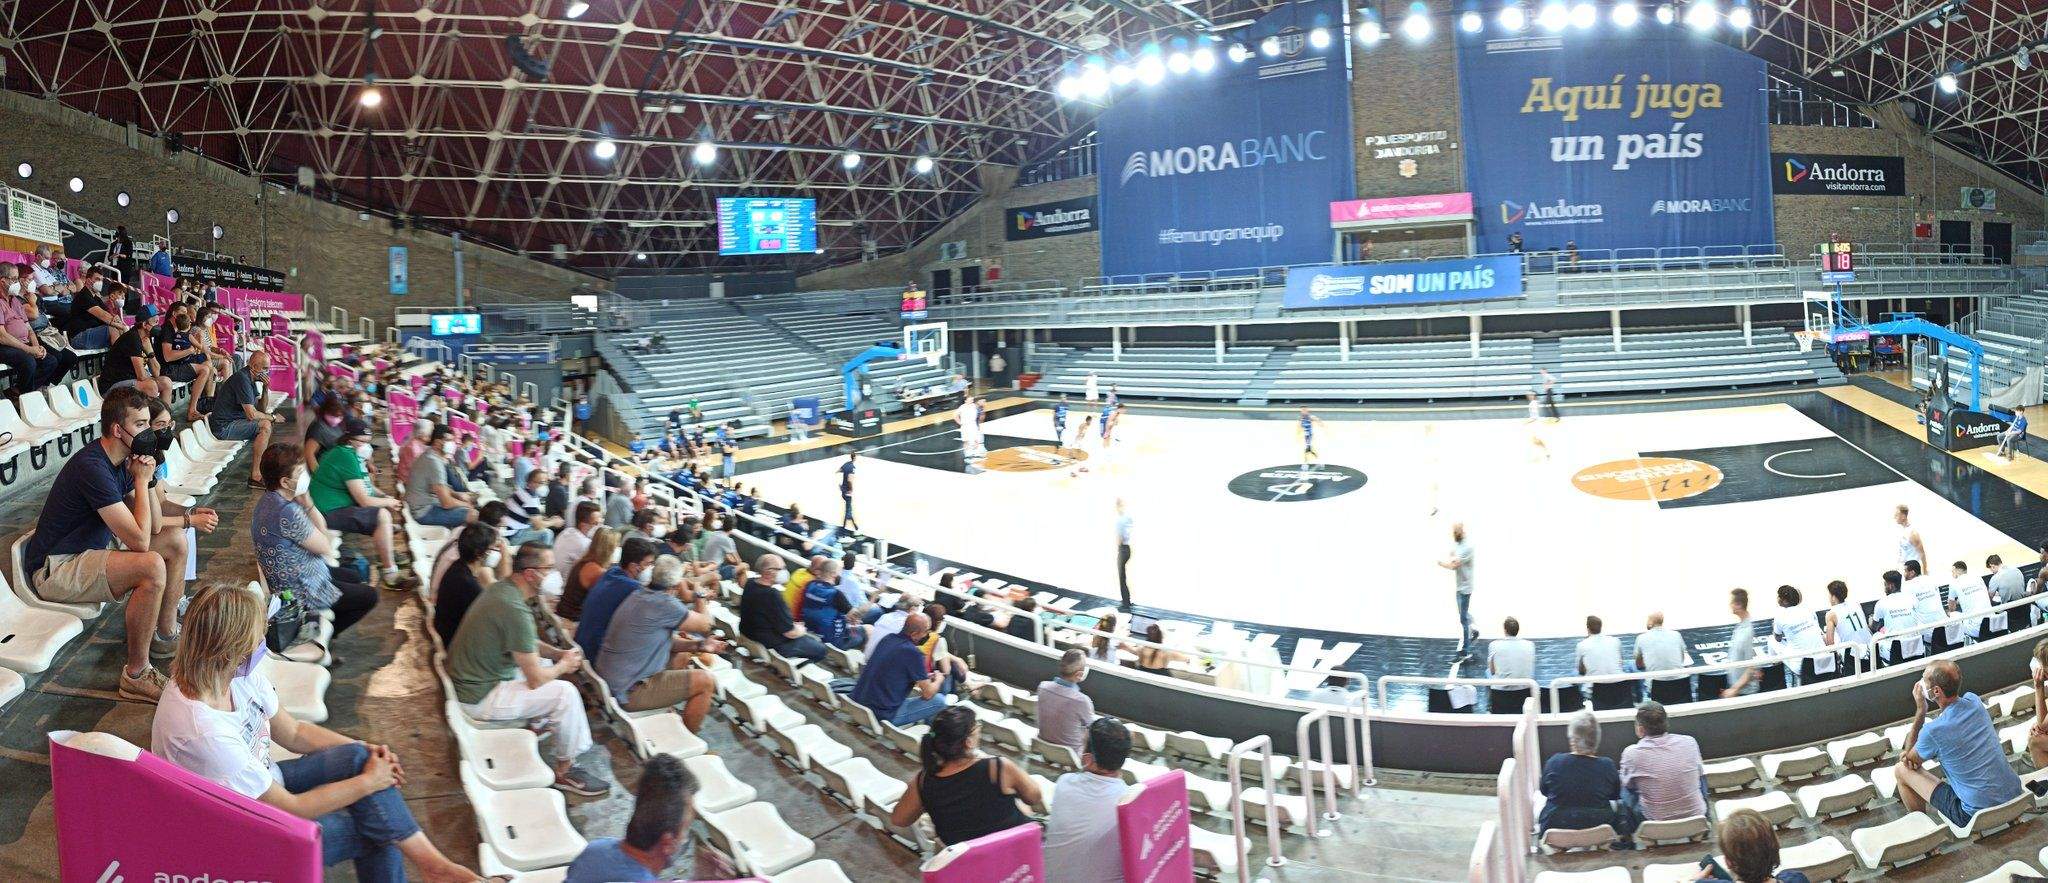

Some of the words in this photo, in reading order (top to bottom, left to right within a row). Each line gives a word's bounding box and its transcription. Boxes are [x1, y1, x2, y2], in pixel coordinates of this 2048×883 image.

[1520, 74, 1626, 122] Aquí
[1630, 74, 1723, 119] juga
[1150, 131, 1327, 178] MORABANC
[1550, 133, 1605, 162] un
[1612, 122, 1704, 171] país
[1808, 162, 1886, 181] Andorra
[1825, 182, 1886, 191] visitandorra.com
[1524, 199, 1603, 219] Andorra
[1666, 198, 1751, 214] MORABANC
[1033, 208, 1091, 227] Andorra
[1158, 222, 1285, 246] #femungranequip
[1837, 253, 1851, 270] 18
[1369, 273, 1415, 295] SOM
[1416, 272, 1447, 292] UN
[1448, 264, 1495, 291] PAÍS
[1966, 422, 2000, 435] Andorra
[1846, 611, 1864, 632] 11
